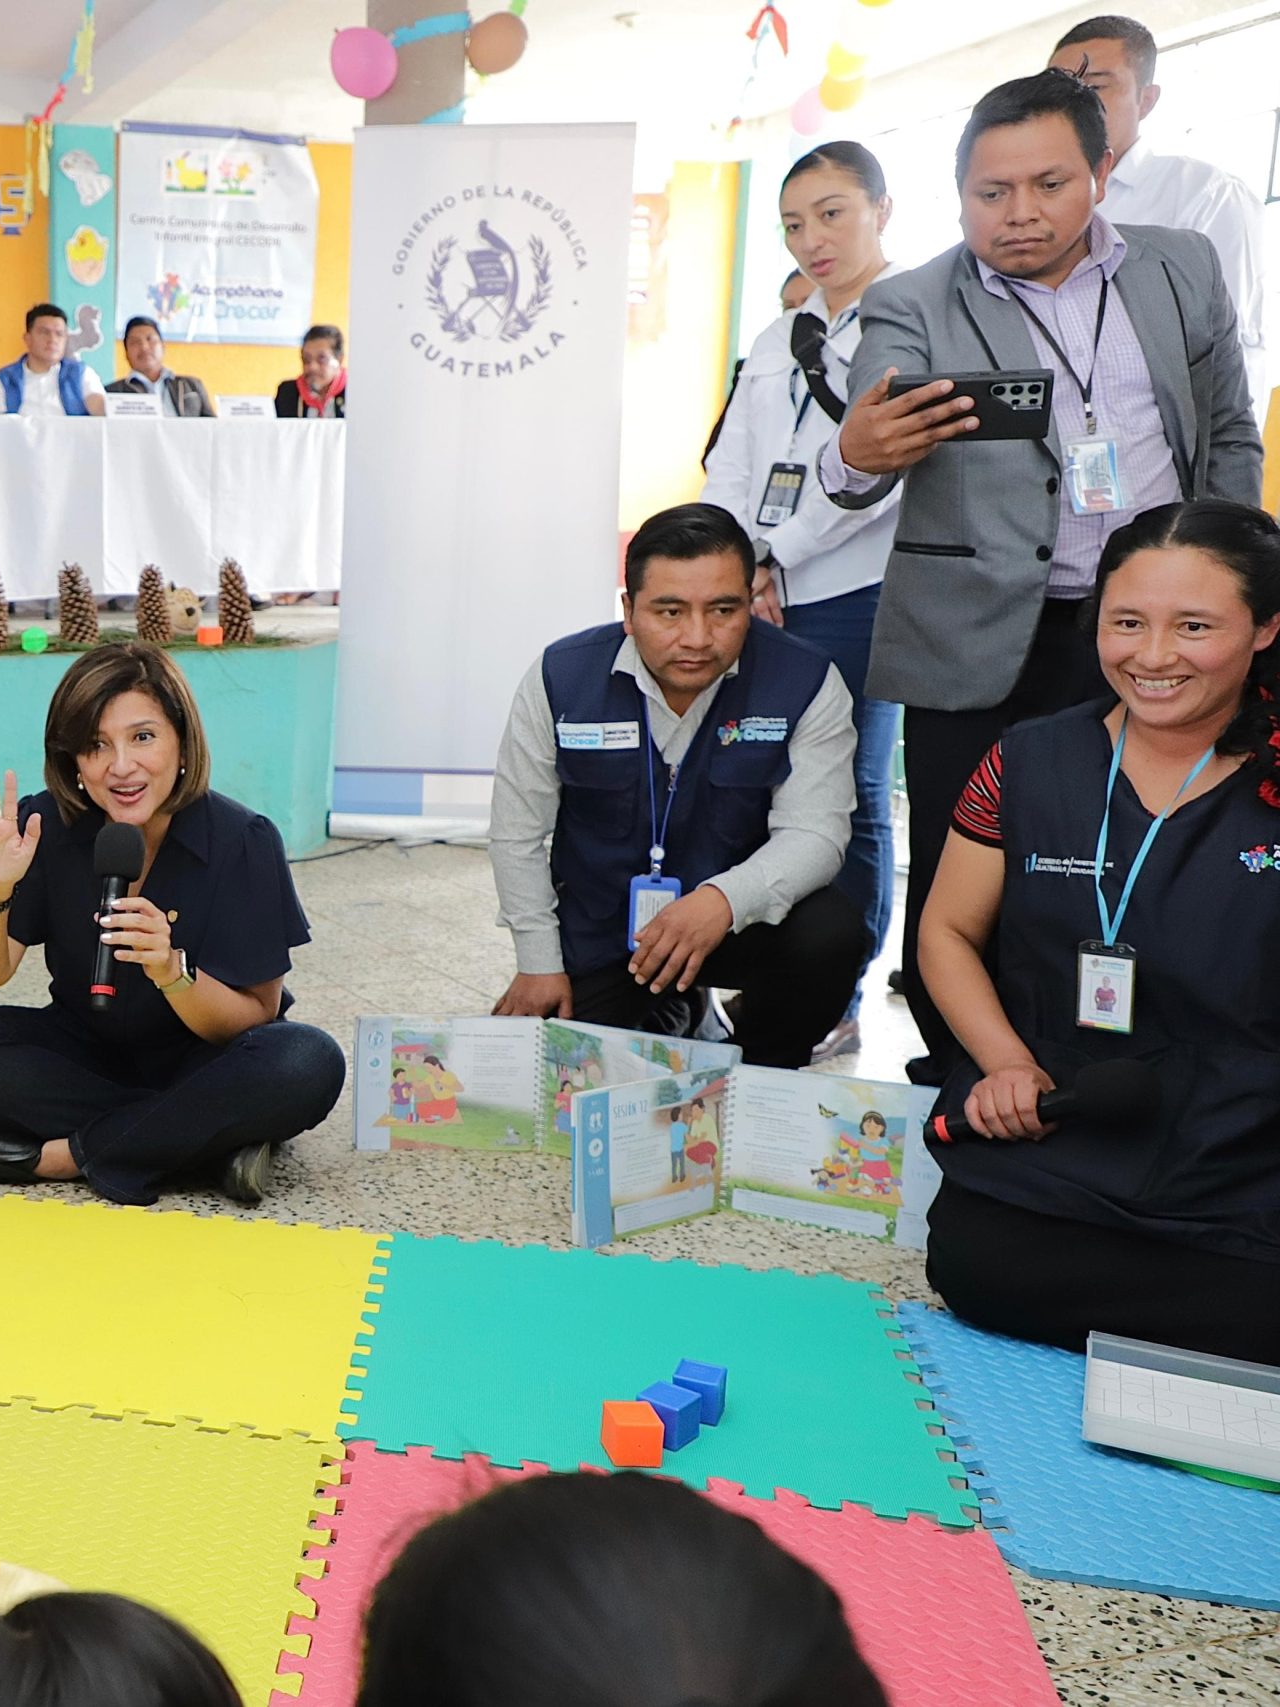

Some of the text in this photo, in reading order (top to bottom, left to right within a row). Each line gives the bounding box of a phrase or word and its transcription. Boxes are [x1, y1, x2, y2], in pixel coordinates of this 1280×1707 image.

[392, 184, 588, 275] GOBIERNO DE LA REPÚBLICA
[410, 330, 566, 378] GUATEMALA
[569, 737, 599, 745] Crecer
